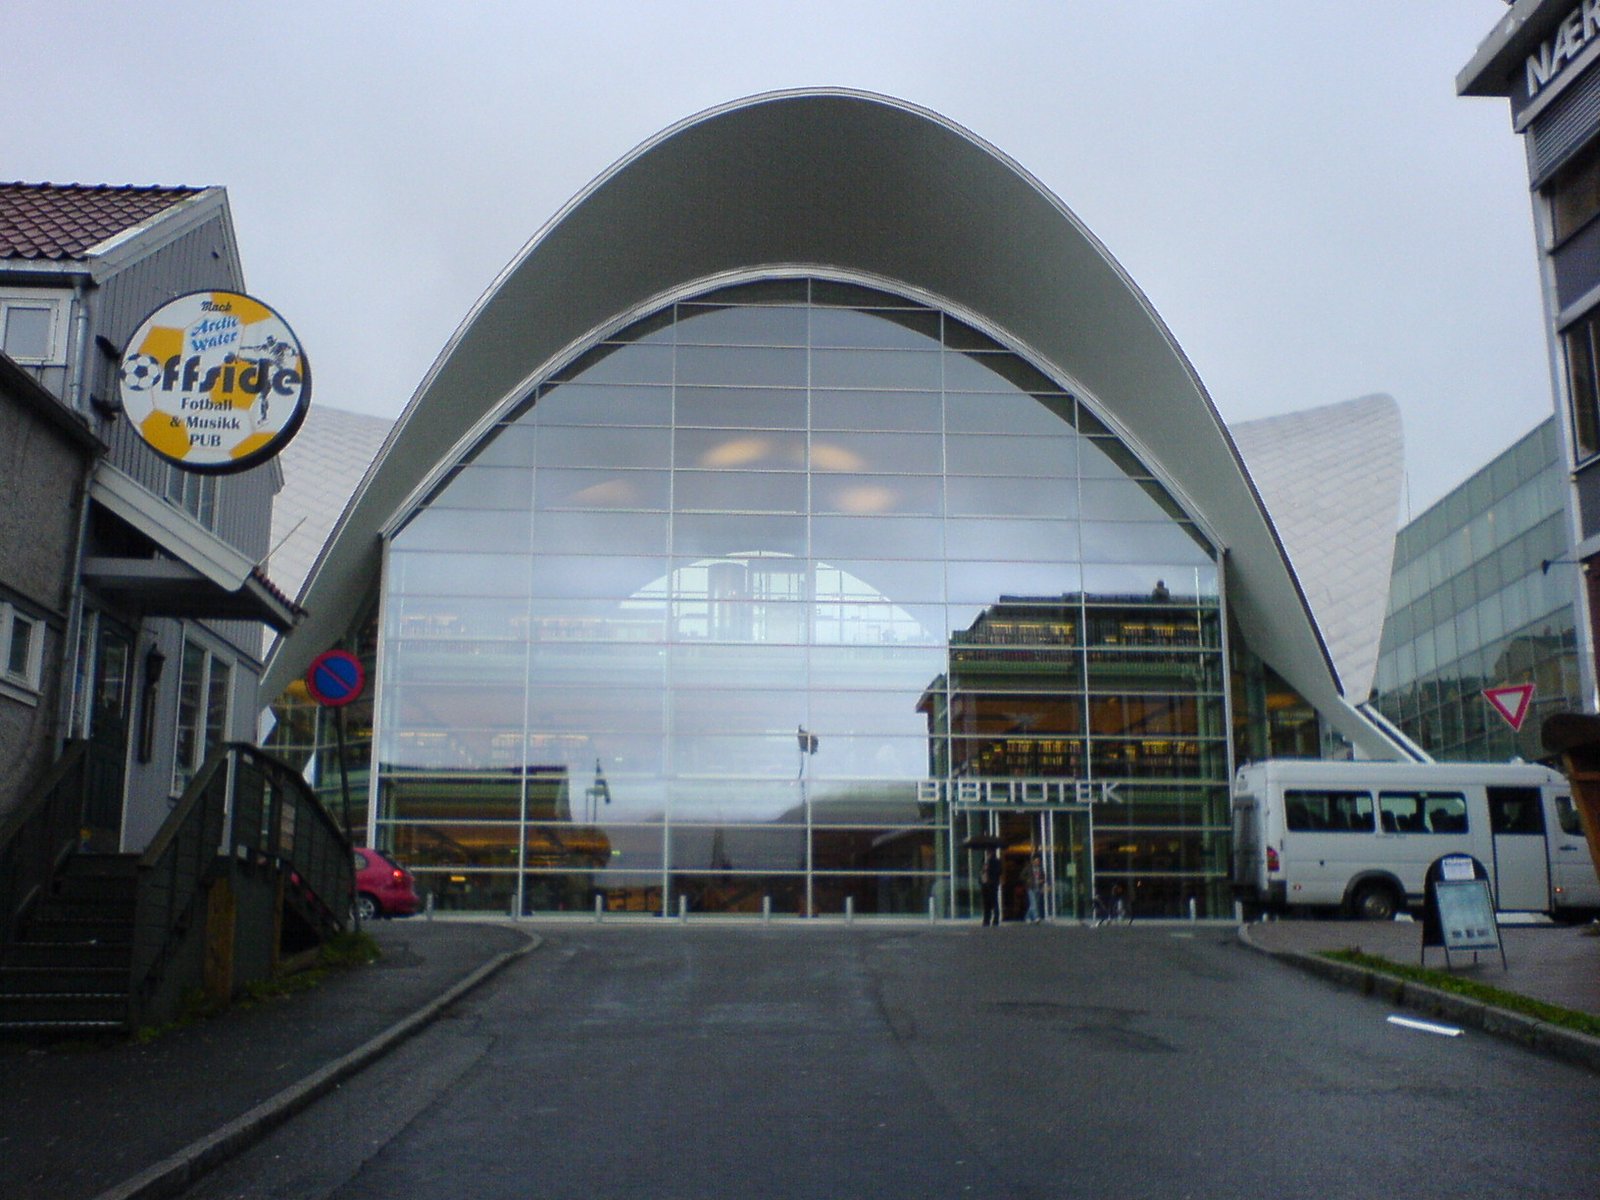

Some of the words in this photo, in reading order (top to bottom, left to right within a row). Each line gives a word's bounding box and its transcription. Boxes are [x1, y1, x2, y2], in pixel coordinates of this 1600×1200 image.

[201, 300, 232, 312] Mack
[191, 315, 239, 337] Arctic
[191, 331, 238, 351] Water
[181, 397, 232, 411] Fotball
[170, 416, 181, 428] &
[186, 416, 240, 430] Musikk
[189, 434, 221, 447] PUB
[917, 780, 1124, 803] BIBLIOTEK
